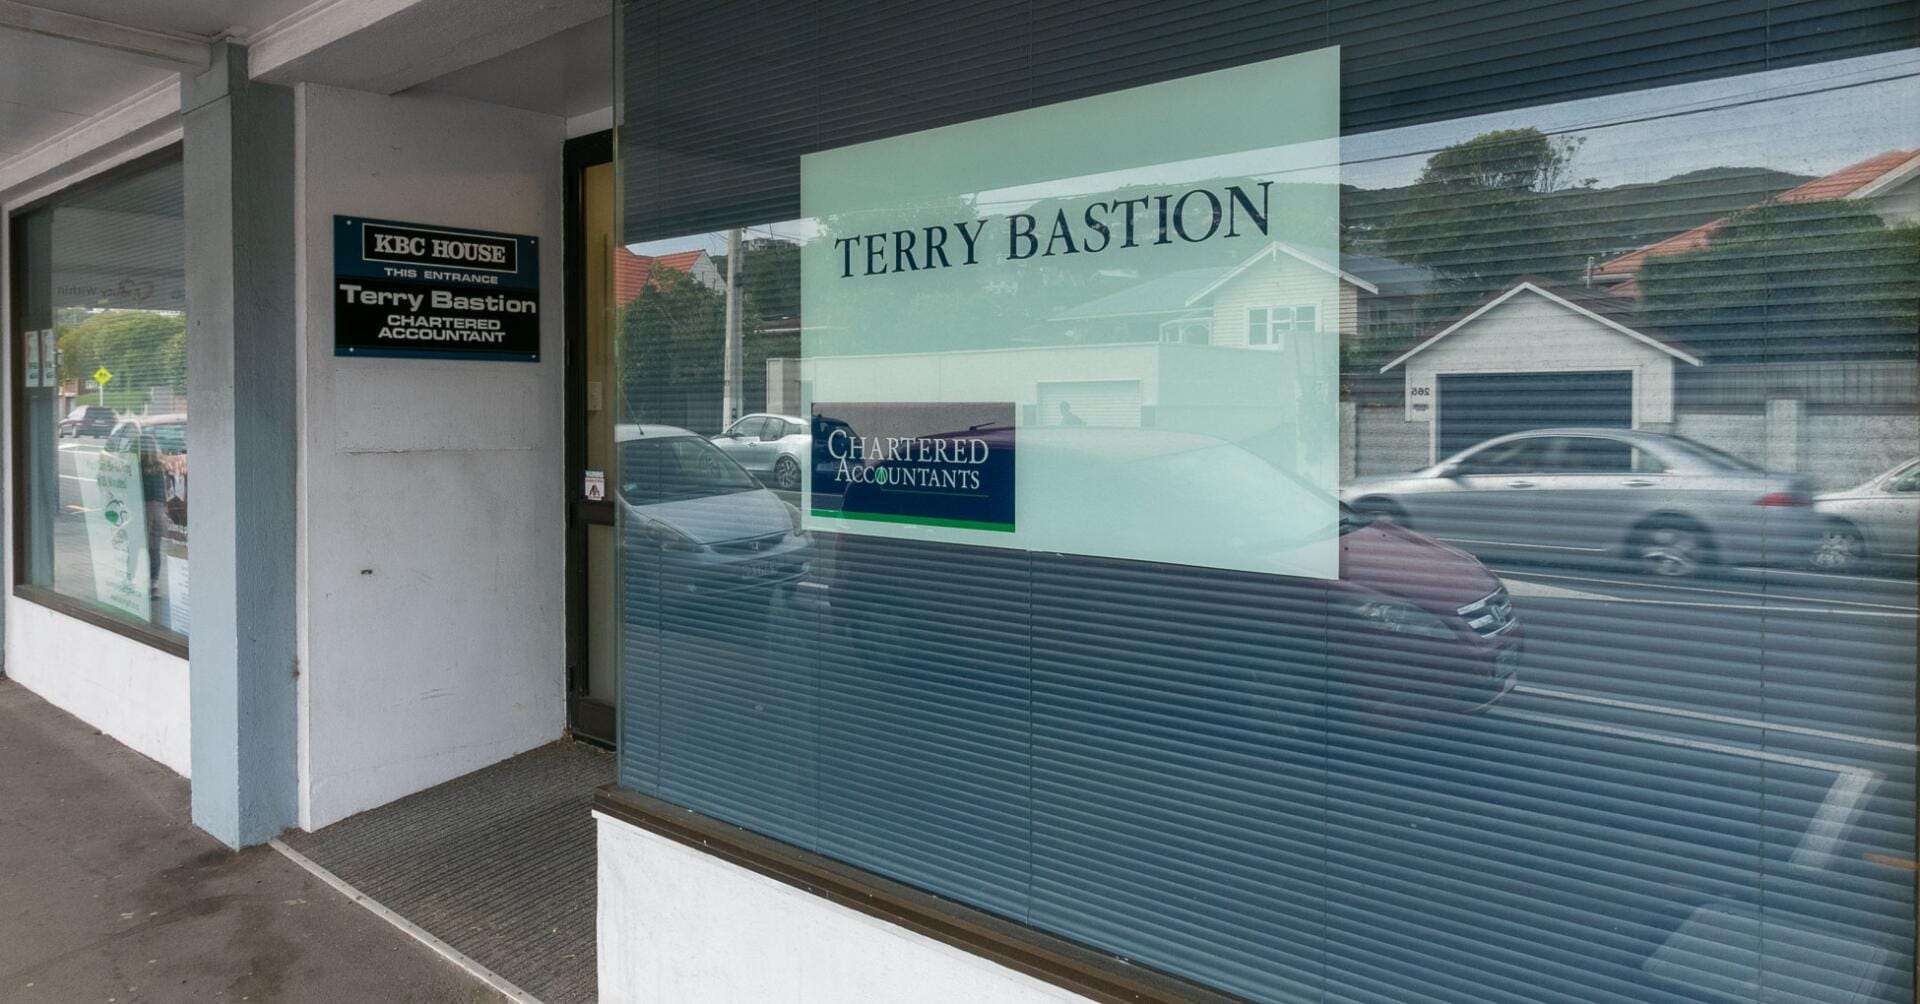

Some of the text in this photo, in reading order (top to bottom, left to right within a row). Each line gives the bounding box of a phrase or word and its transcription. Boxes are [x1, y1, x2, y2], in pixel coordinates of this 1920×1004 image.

[834, 180, 1275, 279] TERRY BASTION
[374, 233, 506, 264] KBC HOUSE
[384, 267, 499, 285] THIS ENTRANCE
[339, 283, 537, 314] Terry Bastion
[377, 327, 506, 343] ACCOUNTANT
[387, 314, 501, 330] CHARTERED
[827, 429, 990, 465] CHARTERED
[834, 456, 981, 490] ACCOUNTANTS
